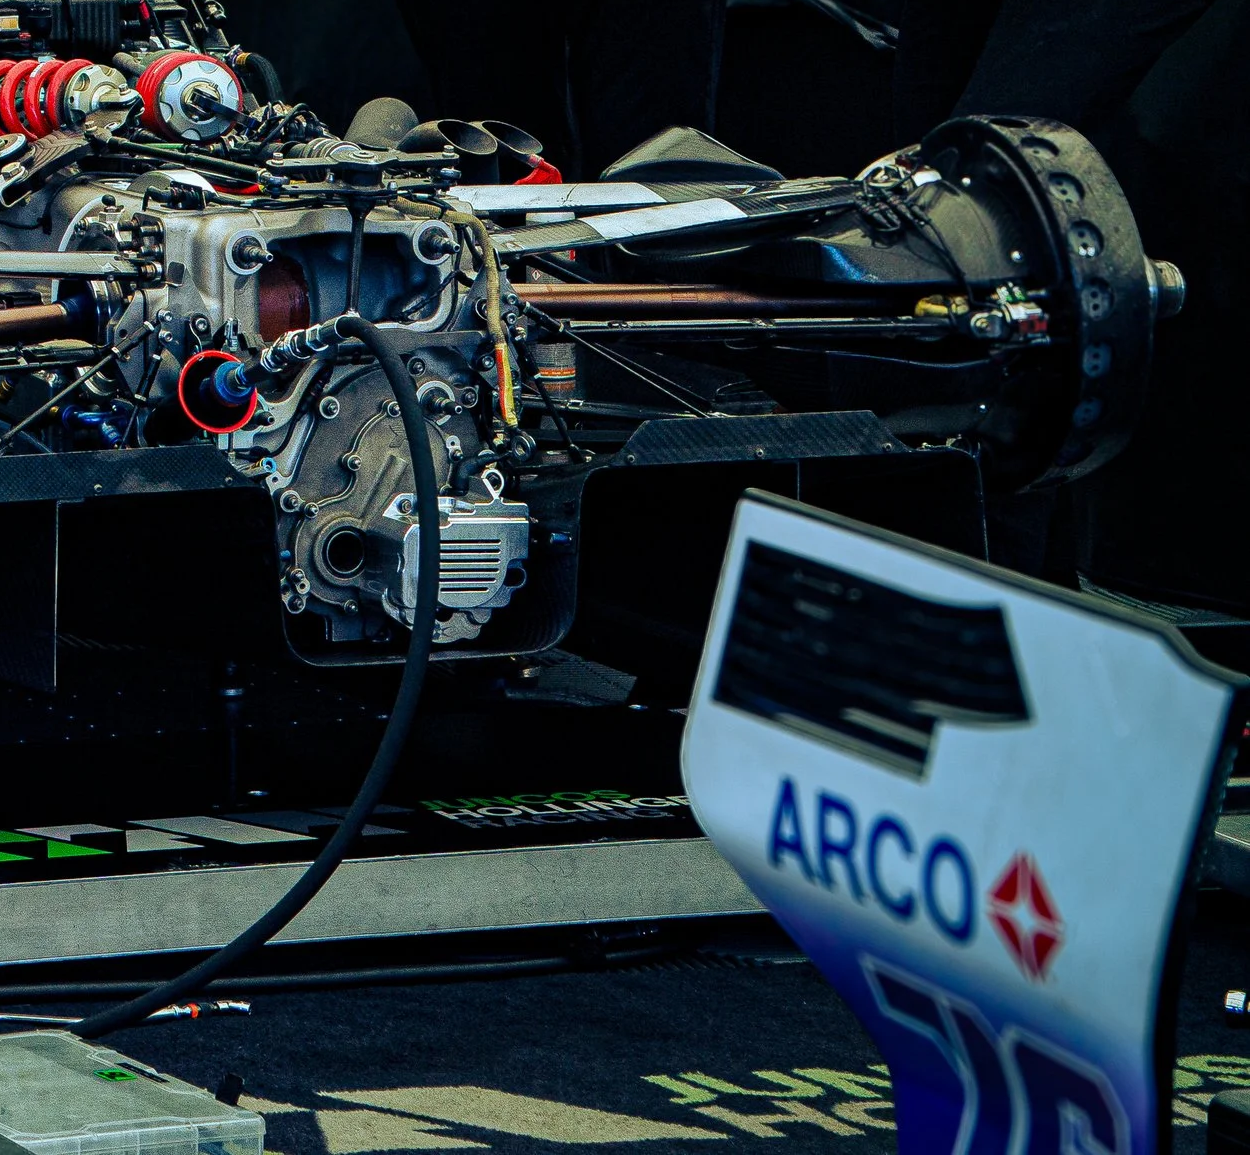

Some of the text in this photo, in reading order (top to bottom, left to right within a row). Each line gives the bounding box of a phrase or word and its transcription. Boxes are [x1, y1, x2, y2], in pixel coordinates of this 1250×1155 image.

[419, 789, 630, 811] JUNCOS
[434, 795, 692, 820] HOLLINGE
[458, 808, 674, 829] RACING
[766, 774, 976, 944] ARCO
